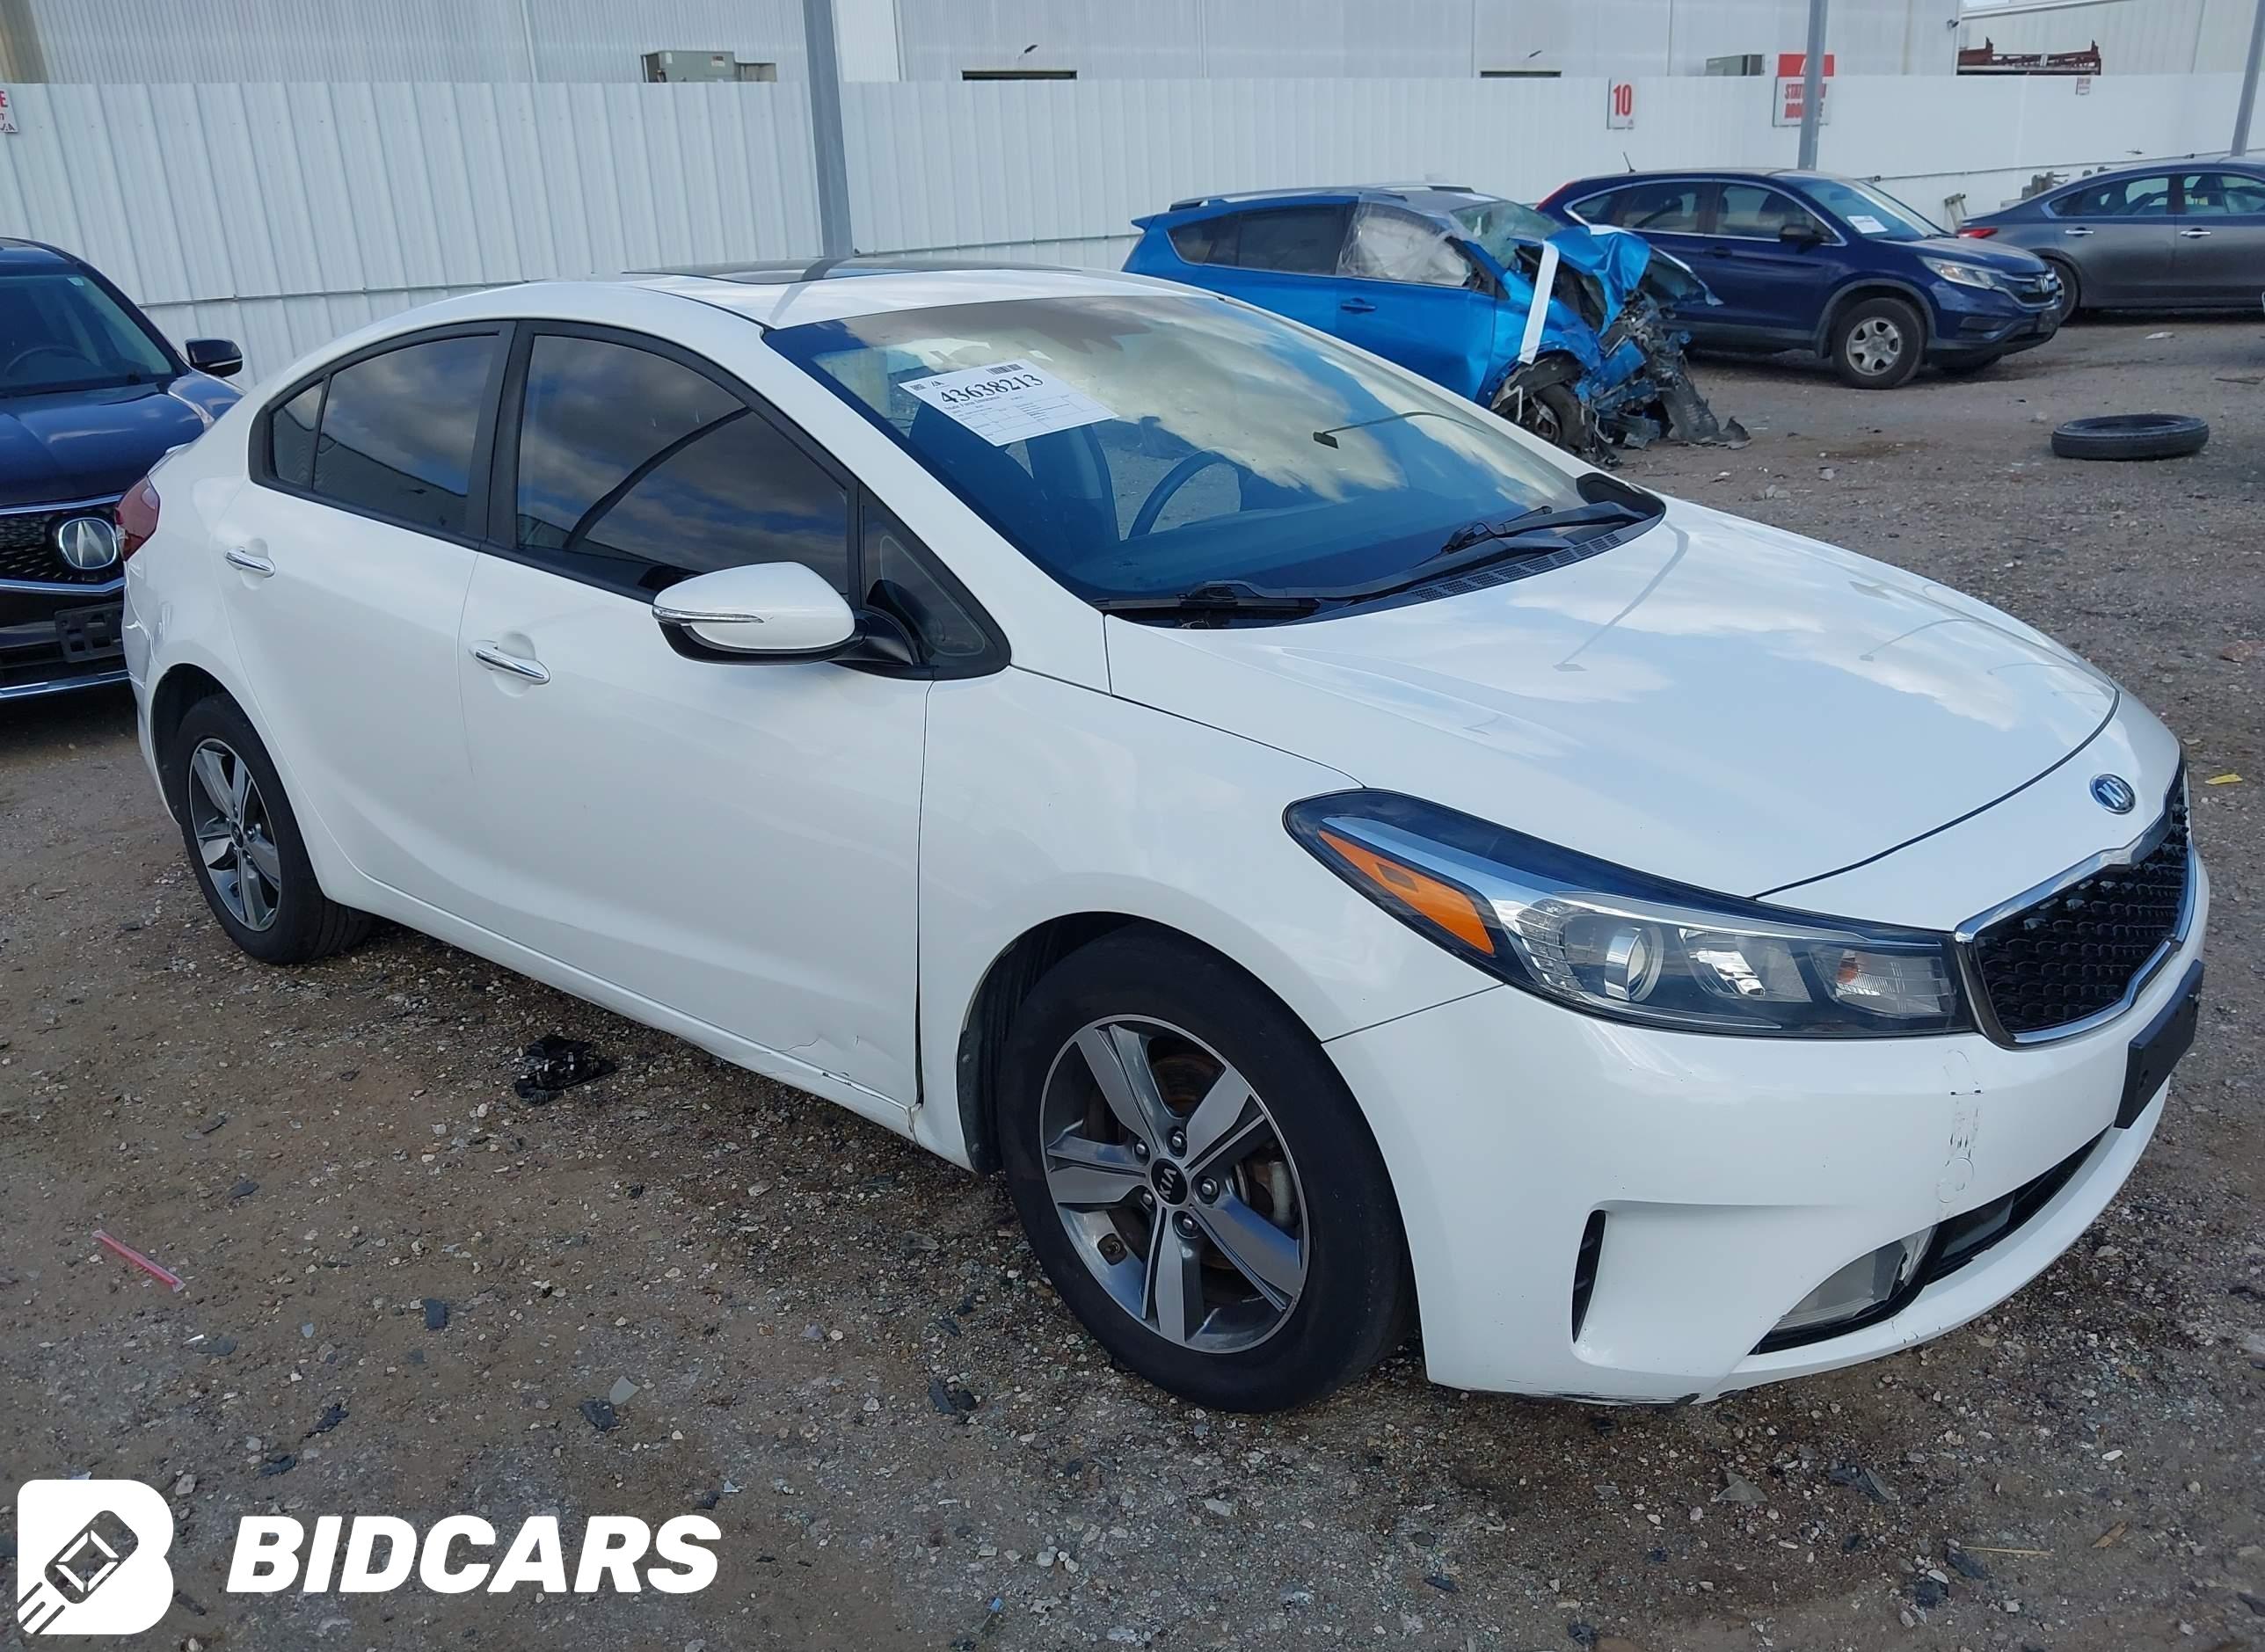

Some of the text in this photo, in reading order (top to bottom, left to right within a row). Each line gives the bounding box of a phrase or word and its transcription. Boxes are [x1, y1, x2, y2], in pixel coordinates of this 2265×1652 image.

[1613, 84, 1632, 116] 10
[941, 374, 1044, 403] 43638213
[1158, 1168, 1177, 1201] KIA
